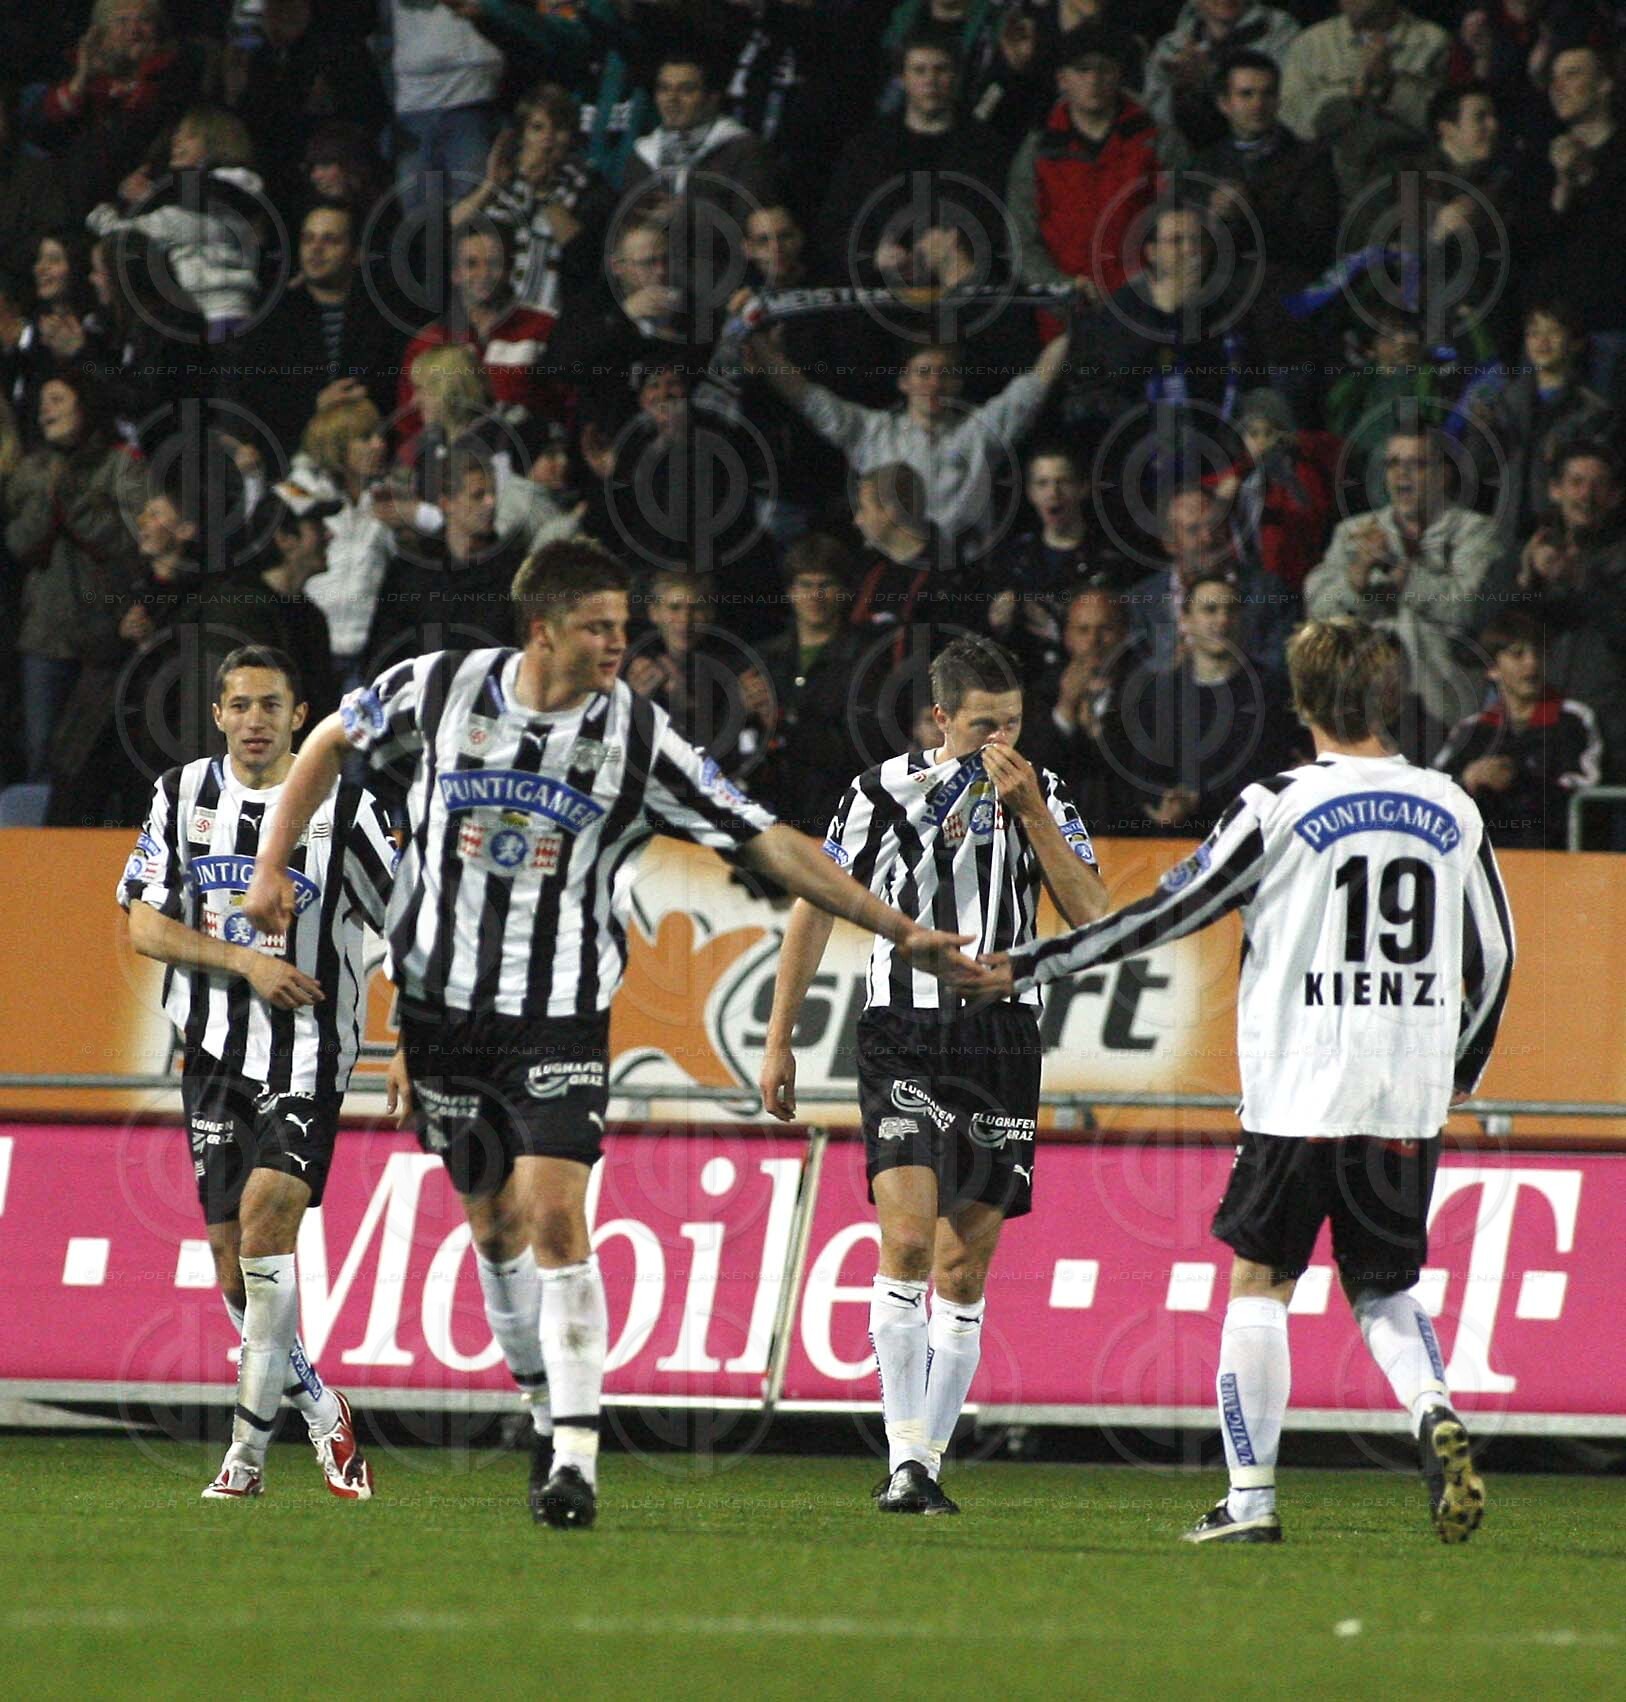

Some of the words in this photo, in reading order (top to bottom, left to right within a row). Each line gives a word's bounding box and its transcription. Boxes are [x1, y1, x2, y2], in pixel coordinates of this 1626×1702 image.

[441, 776, 596, 828] PUNTIGAMER
[1302, 799, 1459, 853] PUNTIGAMER
[1336, 855, 1436, 965] 19
[743, 959, 1170, 1078] srt
[893, 1080, 955, 1124] FLUGHAFEN
[971, 1112, 1036, 1129] FLUGHAFEN
[1007, 1129, 1034, 1141] GRAZ
[1427, 1168, 1582, 1394] T
